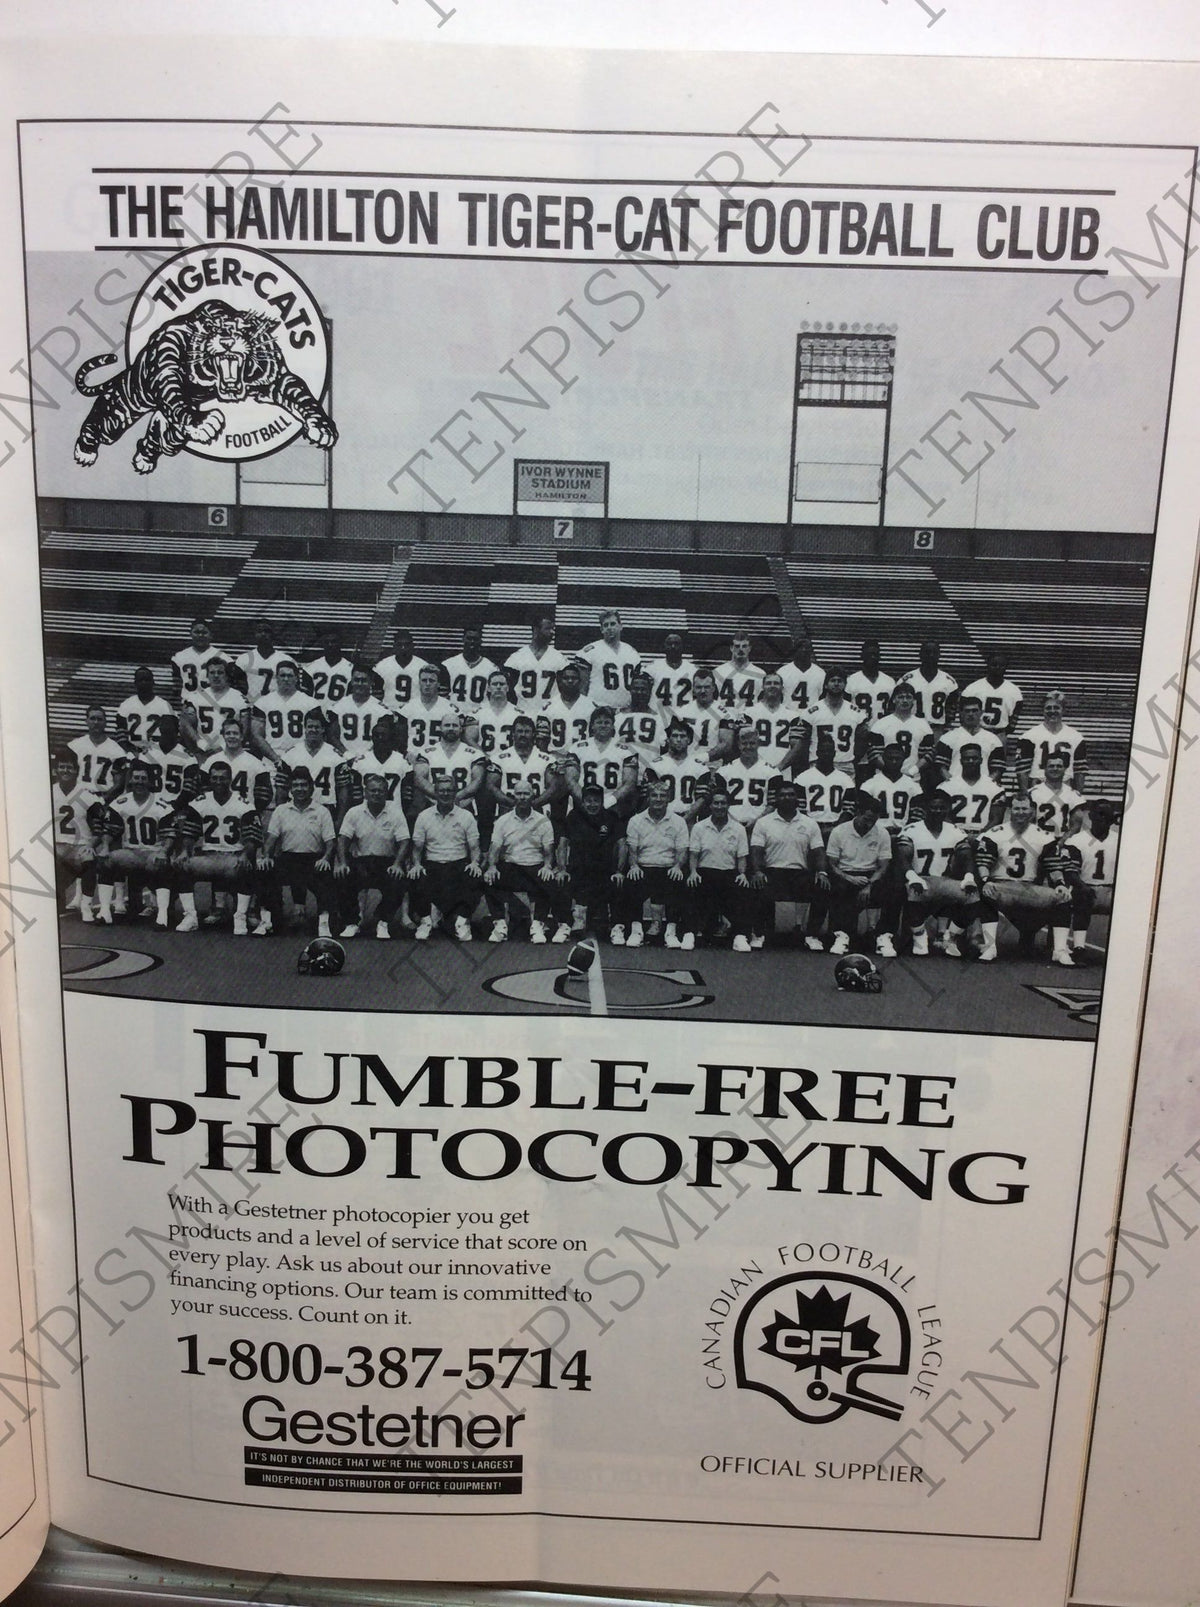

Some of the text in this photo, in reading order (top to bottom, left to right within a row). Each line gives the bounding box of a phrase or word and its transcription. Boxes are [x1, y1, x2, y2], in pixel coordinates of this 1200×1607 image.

[99, 185, 1100, 262] THE HAMILTON TIGER-CAT FOOTBALL CLUB
[152, 257, 316, 351] TIGER-CATS
[225, 415, 293, 451] FOOTBALL
[521, 466, 602, 479] IVOR WYNNE
[531, 478, 591, 490] STADIUM
[535, 492, 587, 500] HAMILTON
[211, 508, 225, 525] 6
[557, 521, 570, 537] 7
[916, 531, 932, 547] 8
[313, 672, 347, 701] 26
[395, 674, 412, 702] 9
[453, 674, 487, 703] 40
[521, 669, 556, 700] 97
[656, 678, 692, 707] 42
[719, 678, 755, 708] 44
[915, 691, 947, 719] 18
[268, 710, 304, 739] 98
[342, 713, 373, 741] 91
[552, 718, 588, 748] 93
[618, 717, 657, 744] 49
[755, 719, 790, 748] 92
[82, 754, 113, 786] 17
[583, 761, 620, 790] 66
[728, 777, 767, 806] 25
[808, 784, 844, 814] 20
[877, 790, 909, 820] 19
[951, 794, 988, 824] 27
[1037, 802, 1071, 832] 21
[126, 815, 158, 846] 10
[203, 814, 241, 845] 23
[1006, 847, 1027, 879] 3
[1092, 850, 1105, 880] 1
[192, 1027, 957, 1129] FUMBLE-FREE
[120, 1093, 1030, 1206] PHOTOCOPYING
[167, 1193, 530, 1229] With a Gestetner photocopier you get
[168, 1223, 588, 1251] products and a level of service that score on
[169, 1249, 552, 1276] every play. Ask us about our innovative
[169, 1270, 593, 1303] financing options. Our team is committed to
[170, 1299, 412, 1325] your success. Count on it.
[701, 1242, 943, 1400] CANADIAN FOOTBALL LEAGUE
[775, 1328, 870, 1358] CFL
[177, 1333, 592, 1391] 1-800-387-5714
[242, 1394, 526, 1449] Gestetner
[250, 1451, 514, 1470] IT'S NOT BY CHANCE THAT WE'RE THE WORLD'S LARGEST
[700, 1455, 924, 1483] OFFICIAL SUPPLIER
[262, 1473, 502, 1491] INDEPENDENT DISTRIBUTOR OF OFFICE EQUIPMENT!
